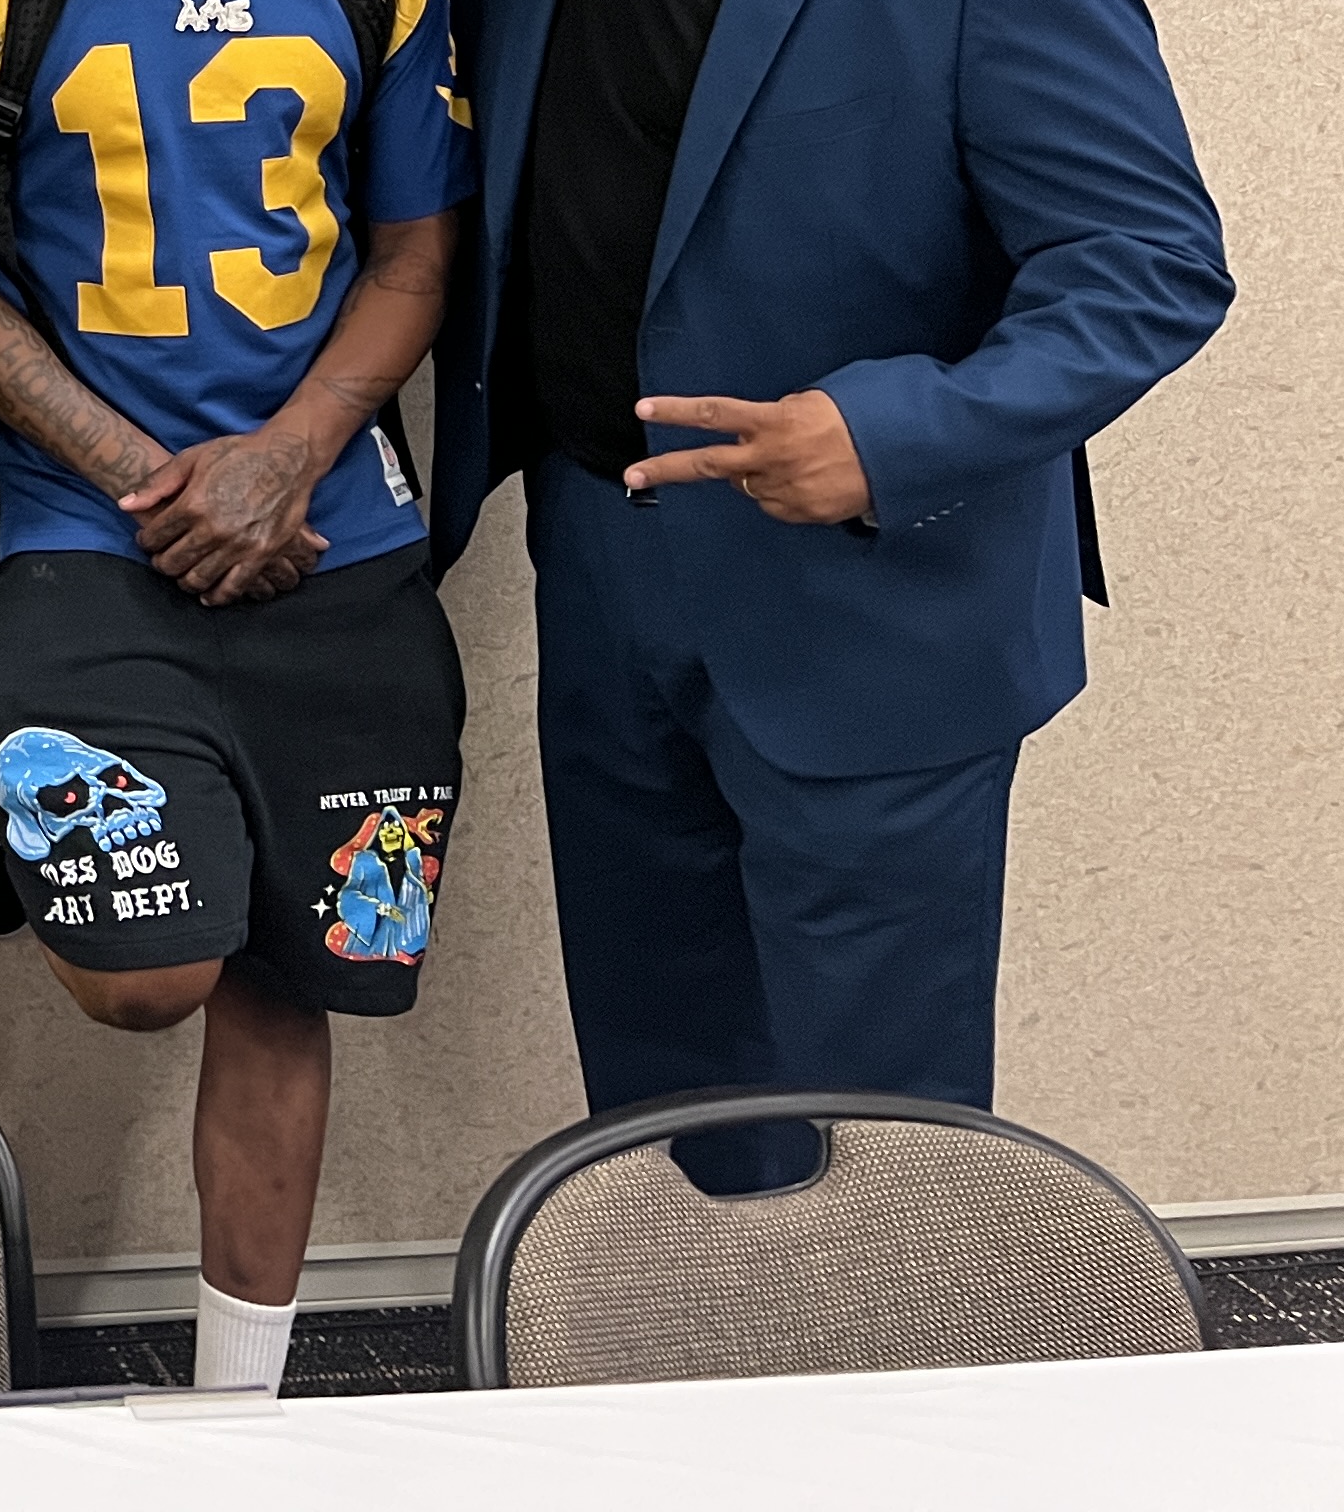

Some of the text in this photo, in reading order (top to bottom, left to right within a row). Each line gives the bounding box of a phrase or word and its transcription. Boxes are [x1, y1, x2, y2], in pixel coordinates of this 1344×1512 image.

[52, 35, 347, 336] 13
[320, 791, 369, 810] NEVER
[373, 787, 412, 804] TRUST
[418, 786, 428, 801] A
[109, 840, 180, 881] DOG
[44, 879, 203, 926] ART DEPT.
